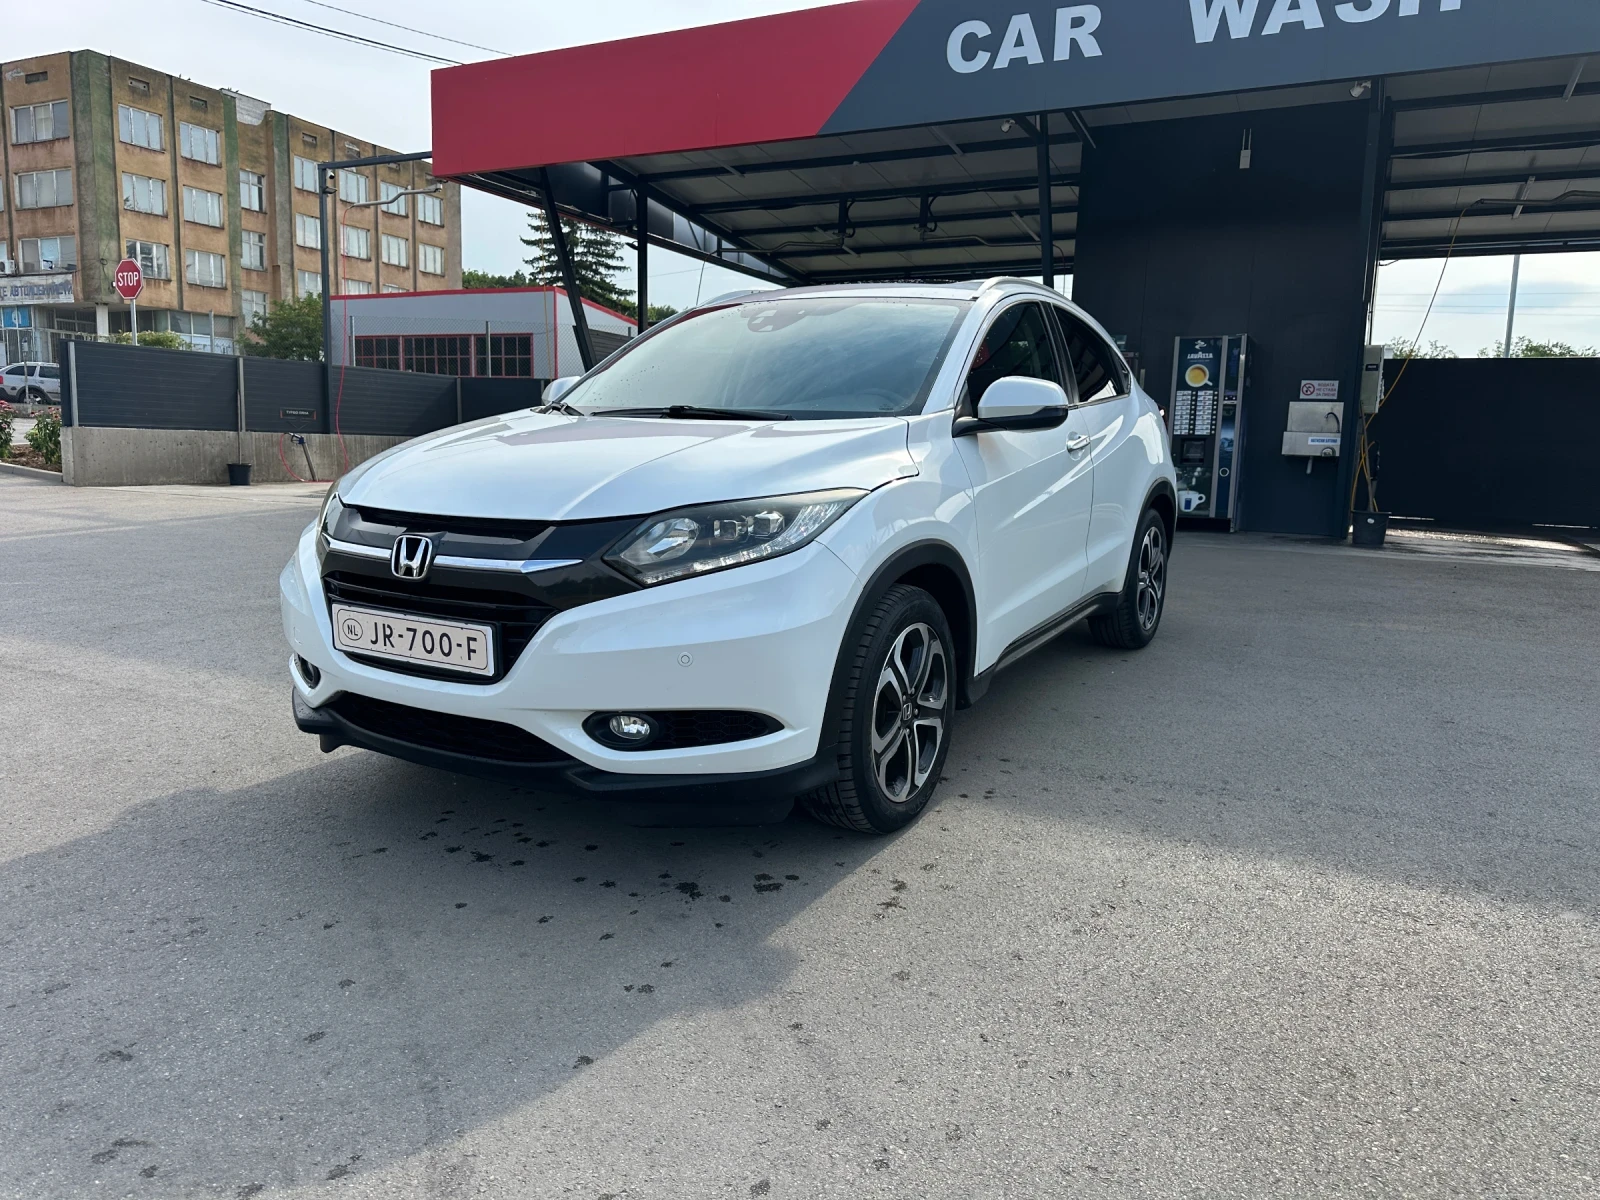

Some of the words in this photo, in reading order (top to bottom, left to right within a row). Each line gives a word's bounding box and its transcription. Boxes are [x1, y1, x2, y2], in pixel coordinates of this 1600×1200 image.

[946, 4, 1103, 74] CAR
[1188, 0, 1461, 44] WA
[118, 272, 139, 287] STOP
[1187, 351, 1213, 359] LAVAZZA
[347, 624, 359, 637] NL
[370, 622, 478, 661] JR-700-F
